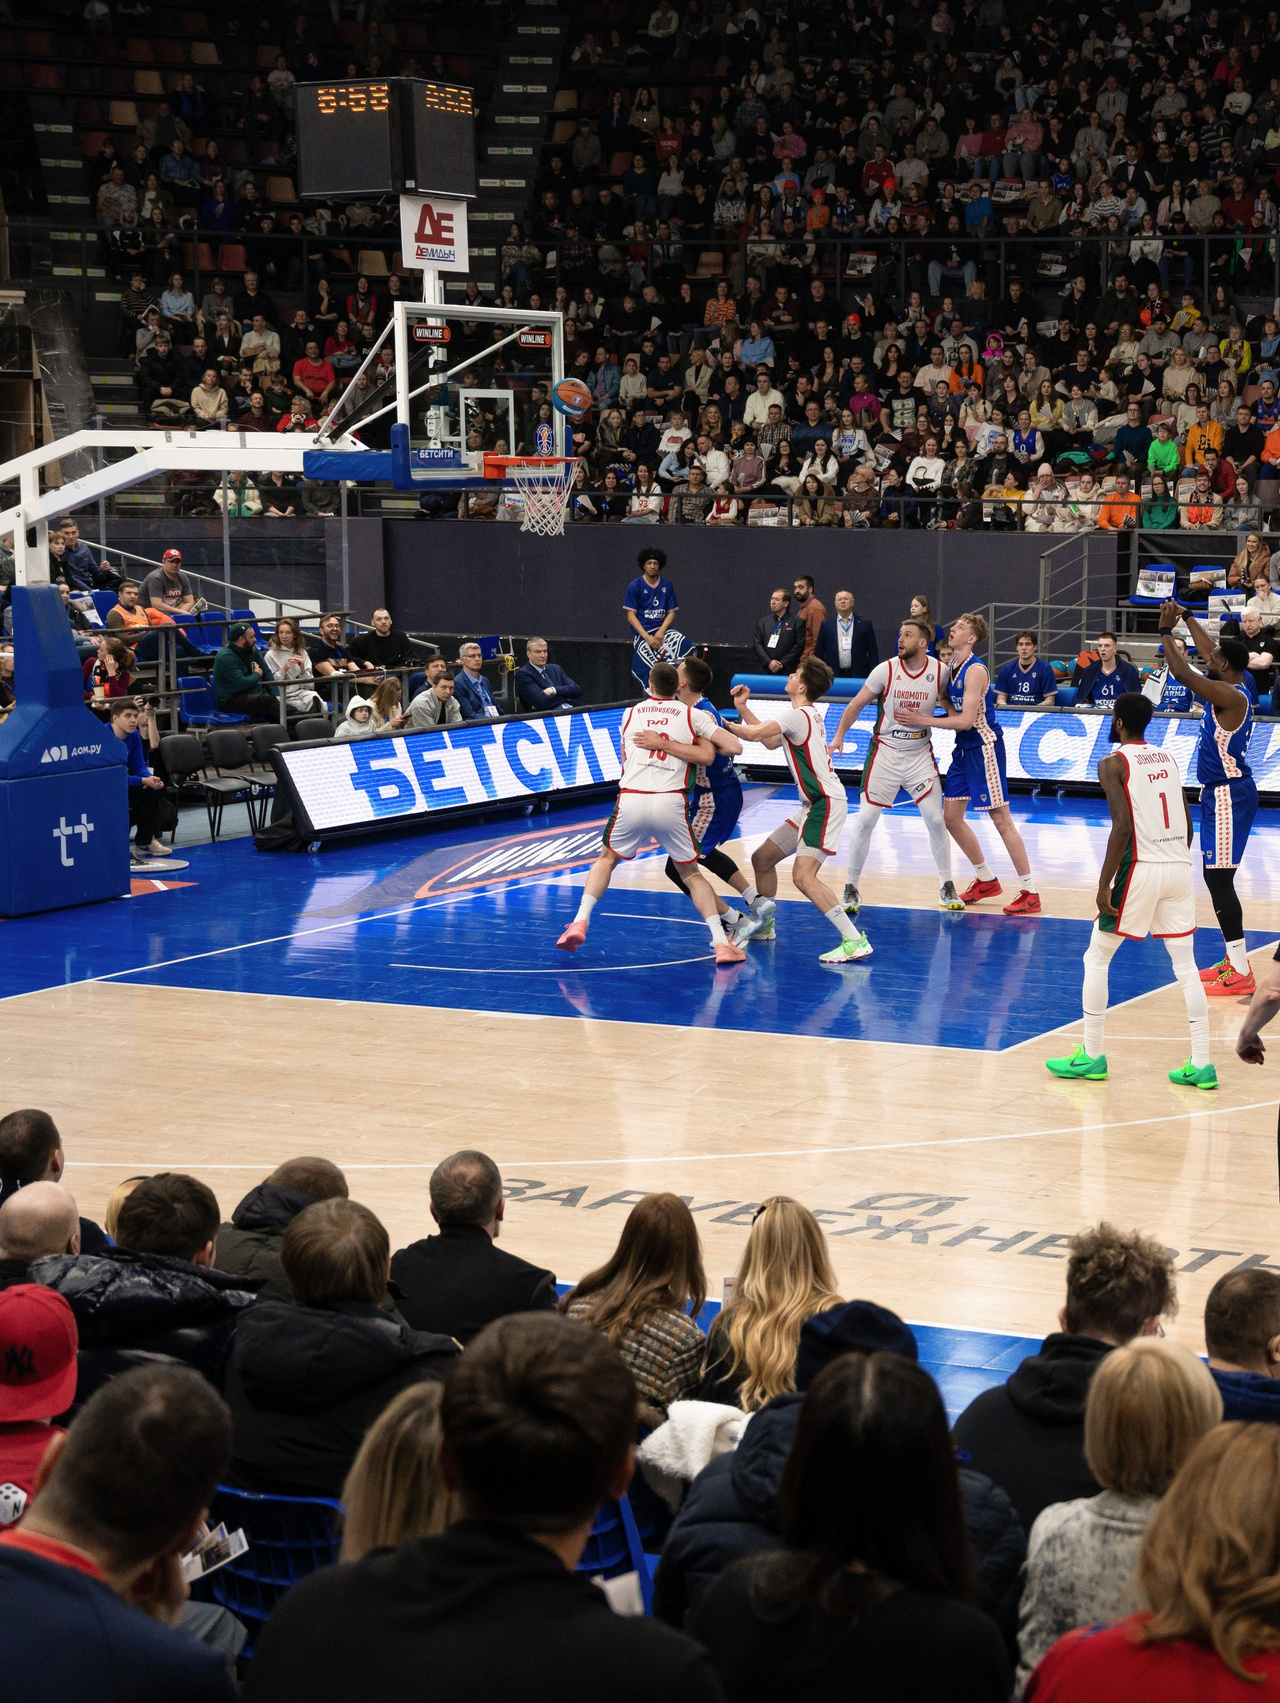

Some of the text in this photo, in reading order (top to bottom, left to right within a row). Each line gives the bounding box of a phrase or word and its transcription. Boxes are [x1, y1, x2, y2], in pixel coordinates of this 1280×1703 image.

[416, 245, 455, 260] ДЕМИДЫЧ
[416, 328, 443, 339] WINLINE
[520, 334, 545, 345] WINLINE
[1020, 444, 1026, 452] 0
[420, 450, 454, 459] БЕТСИТИ
[638, 500, 648, 508] 93
[653, 596, 660, 607] 6
[1018, 682, 1030, 693] 18
[1101, 685, 1114, 696] 61
[894, 690, 929, 701] LOKOMOTIV
[899, 701, 921, 709] KUBAN
[637, 706, 682, 718] KVITKOVSKIKH
[893, 730, 927, 740] МЕЛБЕТ
[350, 709, 622, 818] БЕТСИТ
[1134, 752, 1170, 766] JOHNSON
[1159, 792, 1170, 830] 1
[5, 1345, 36, 1378] NY
[12, 1500, 22, 1517] N
